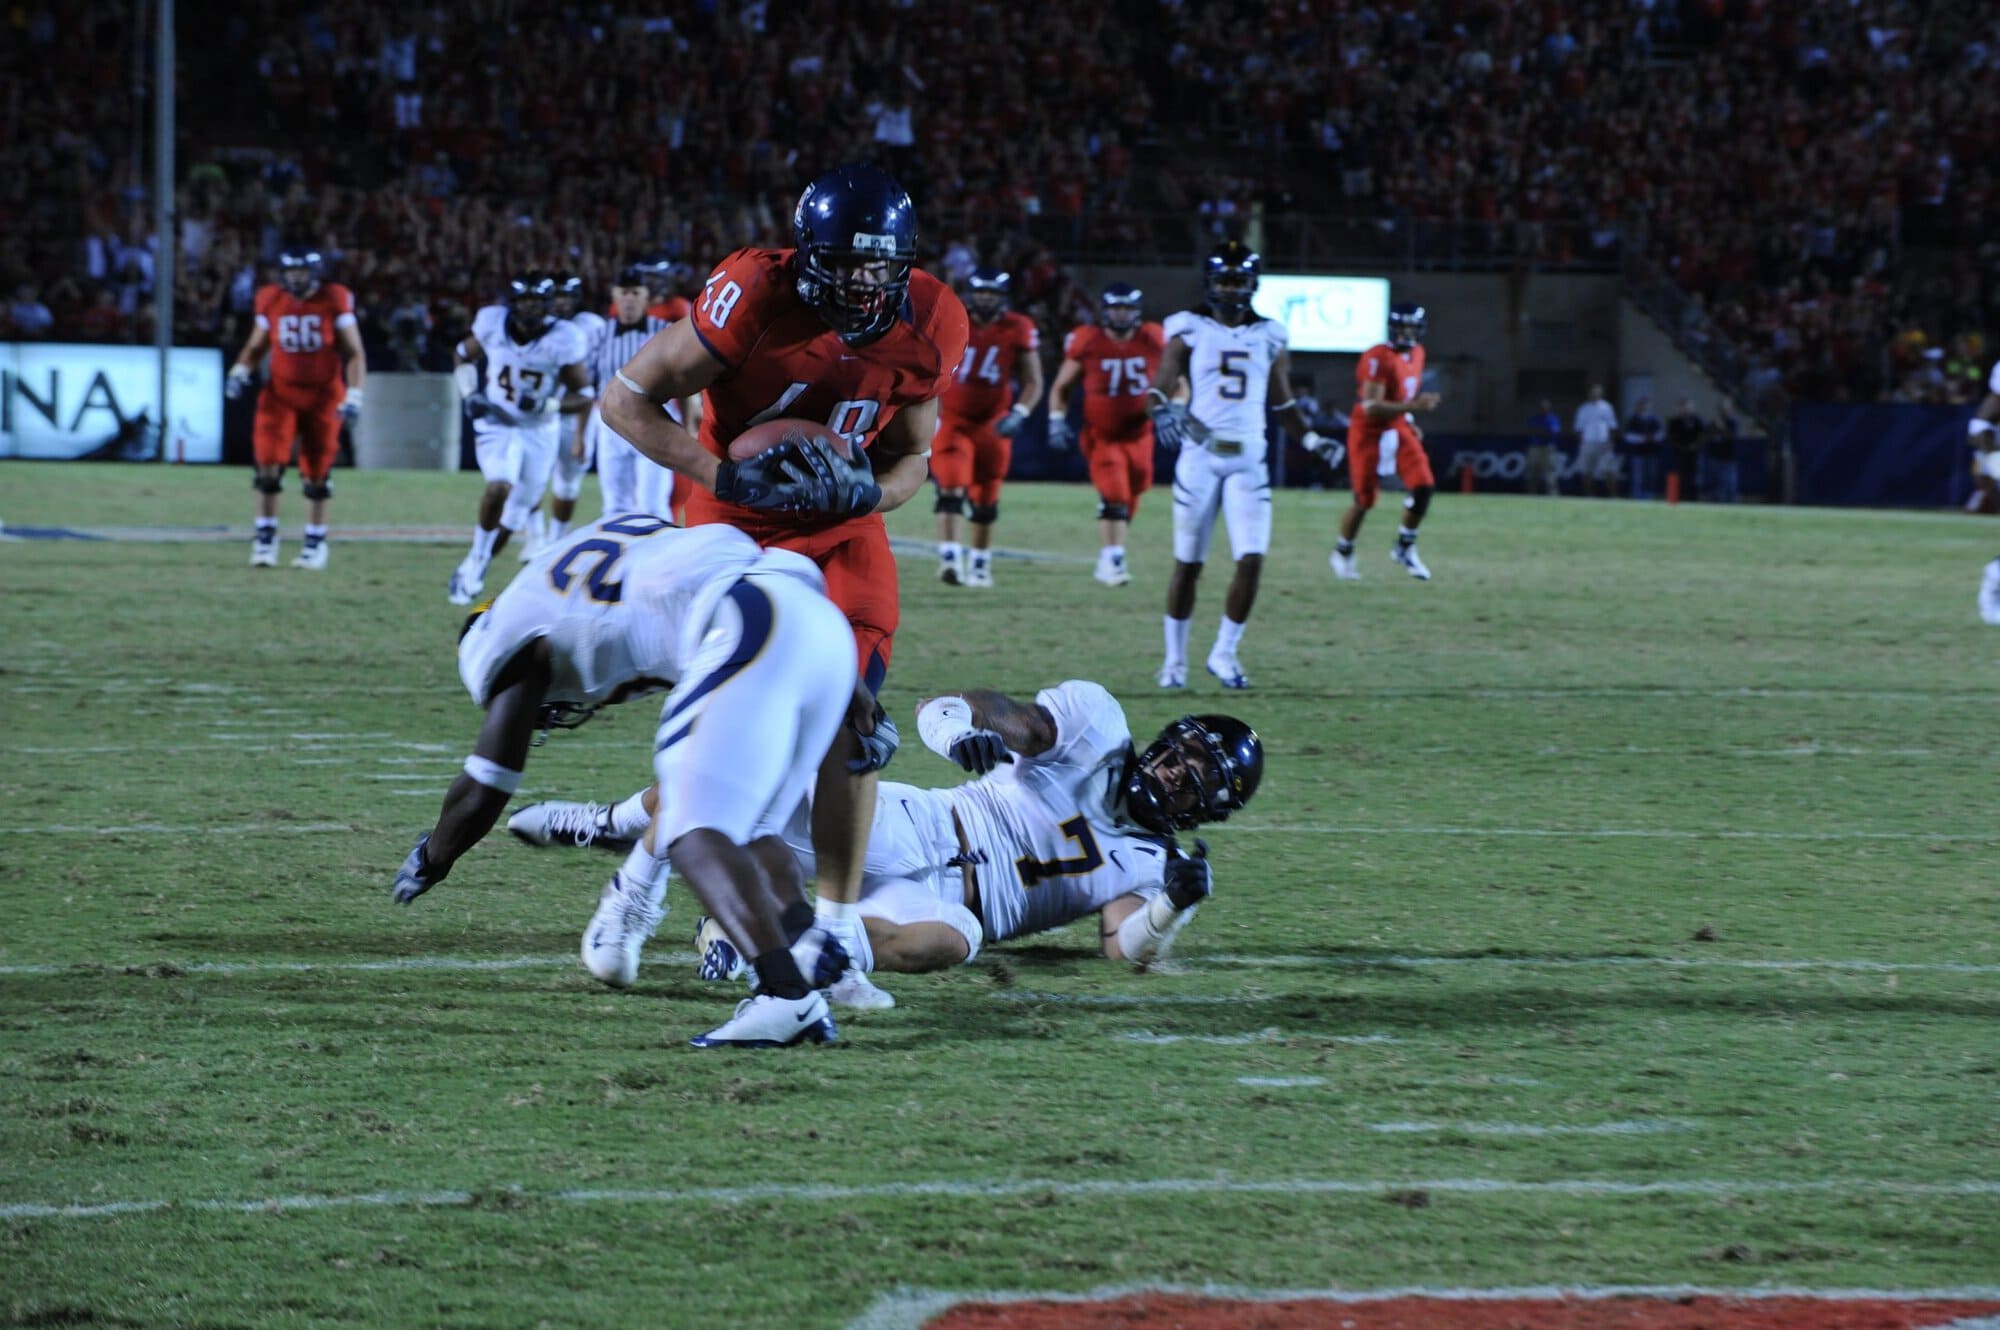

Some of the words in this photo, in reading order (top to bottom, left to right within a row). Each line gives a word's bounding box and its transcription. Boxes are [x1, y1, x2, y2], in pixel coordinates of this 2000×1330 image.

[702, 270, 742, 328] 48
[278, 314, 324, 353] 66
[1101, 355, 1150, 397] 75
[1218, 350, 1251, 404] 5
[1014, 811, 1106, 890] 7
